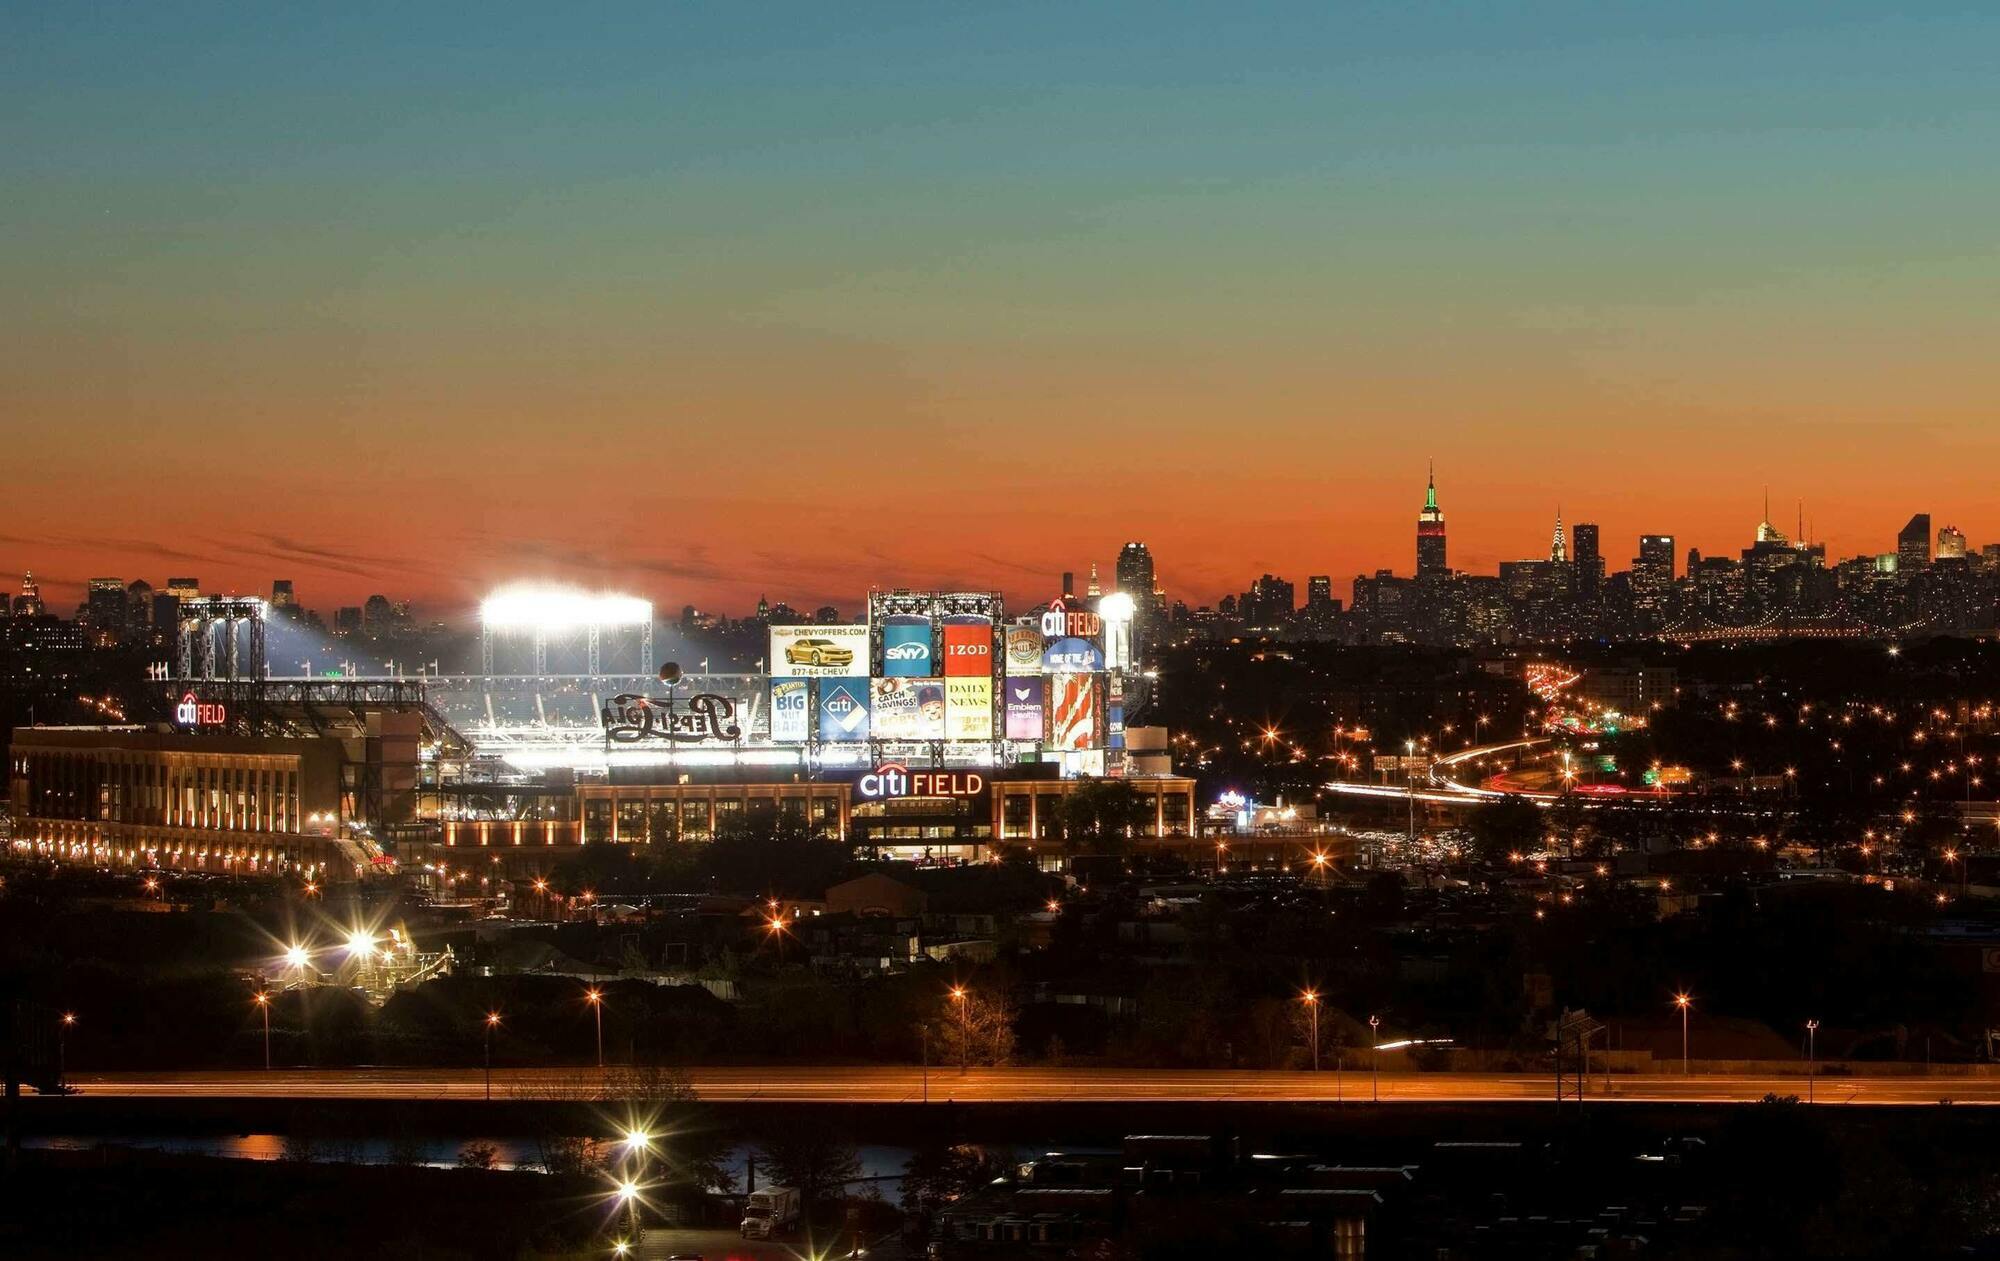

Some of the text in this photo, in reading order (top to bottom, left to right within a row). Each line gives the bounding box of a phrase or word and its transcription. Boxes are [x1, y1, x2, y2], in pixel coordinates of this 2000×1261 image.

[1068, 612, 1100, 636] FIELD
[794, 628, 866, 636] CHEVYOFFERS.COM
[886, 645, 925, 660] SNY
[949, 644, 988, 656] IZOD
[950, 684, 987, 693] DAILY
[776, 695, 804, 710] BIG
[878, 691, 905, 703] CATCH
[951, 698, 988, 706] NEWS
[877, 697, 917, 710] SAVINGS!
[1007, 703, 1042, 711] Emblem
[197, 704, 225, 724] FIELD
[913, 774, 982, 795] FIELD
